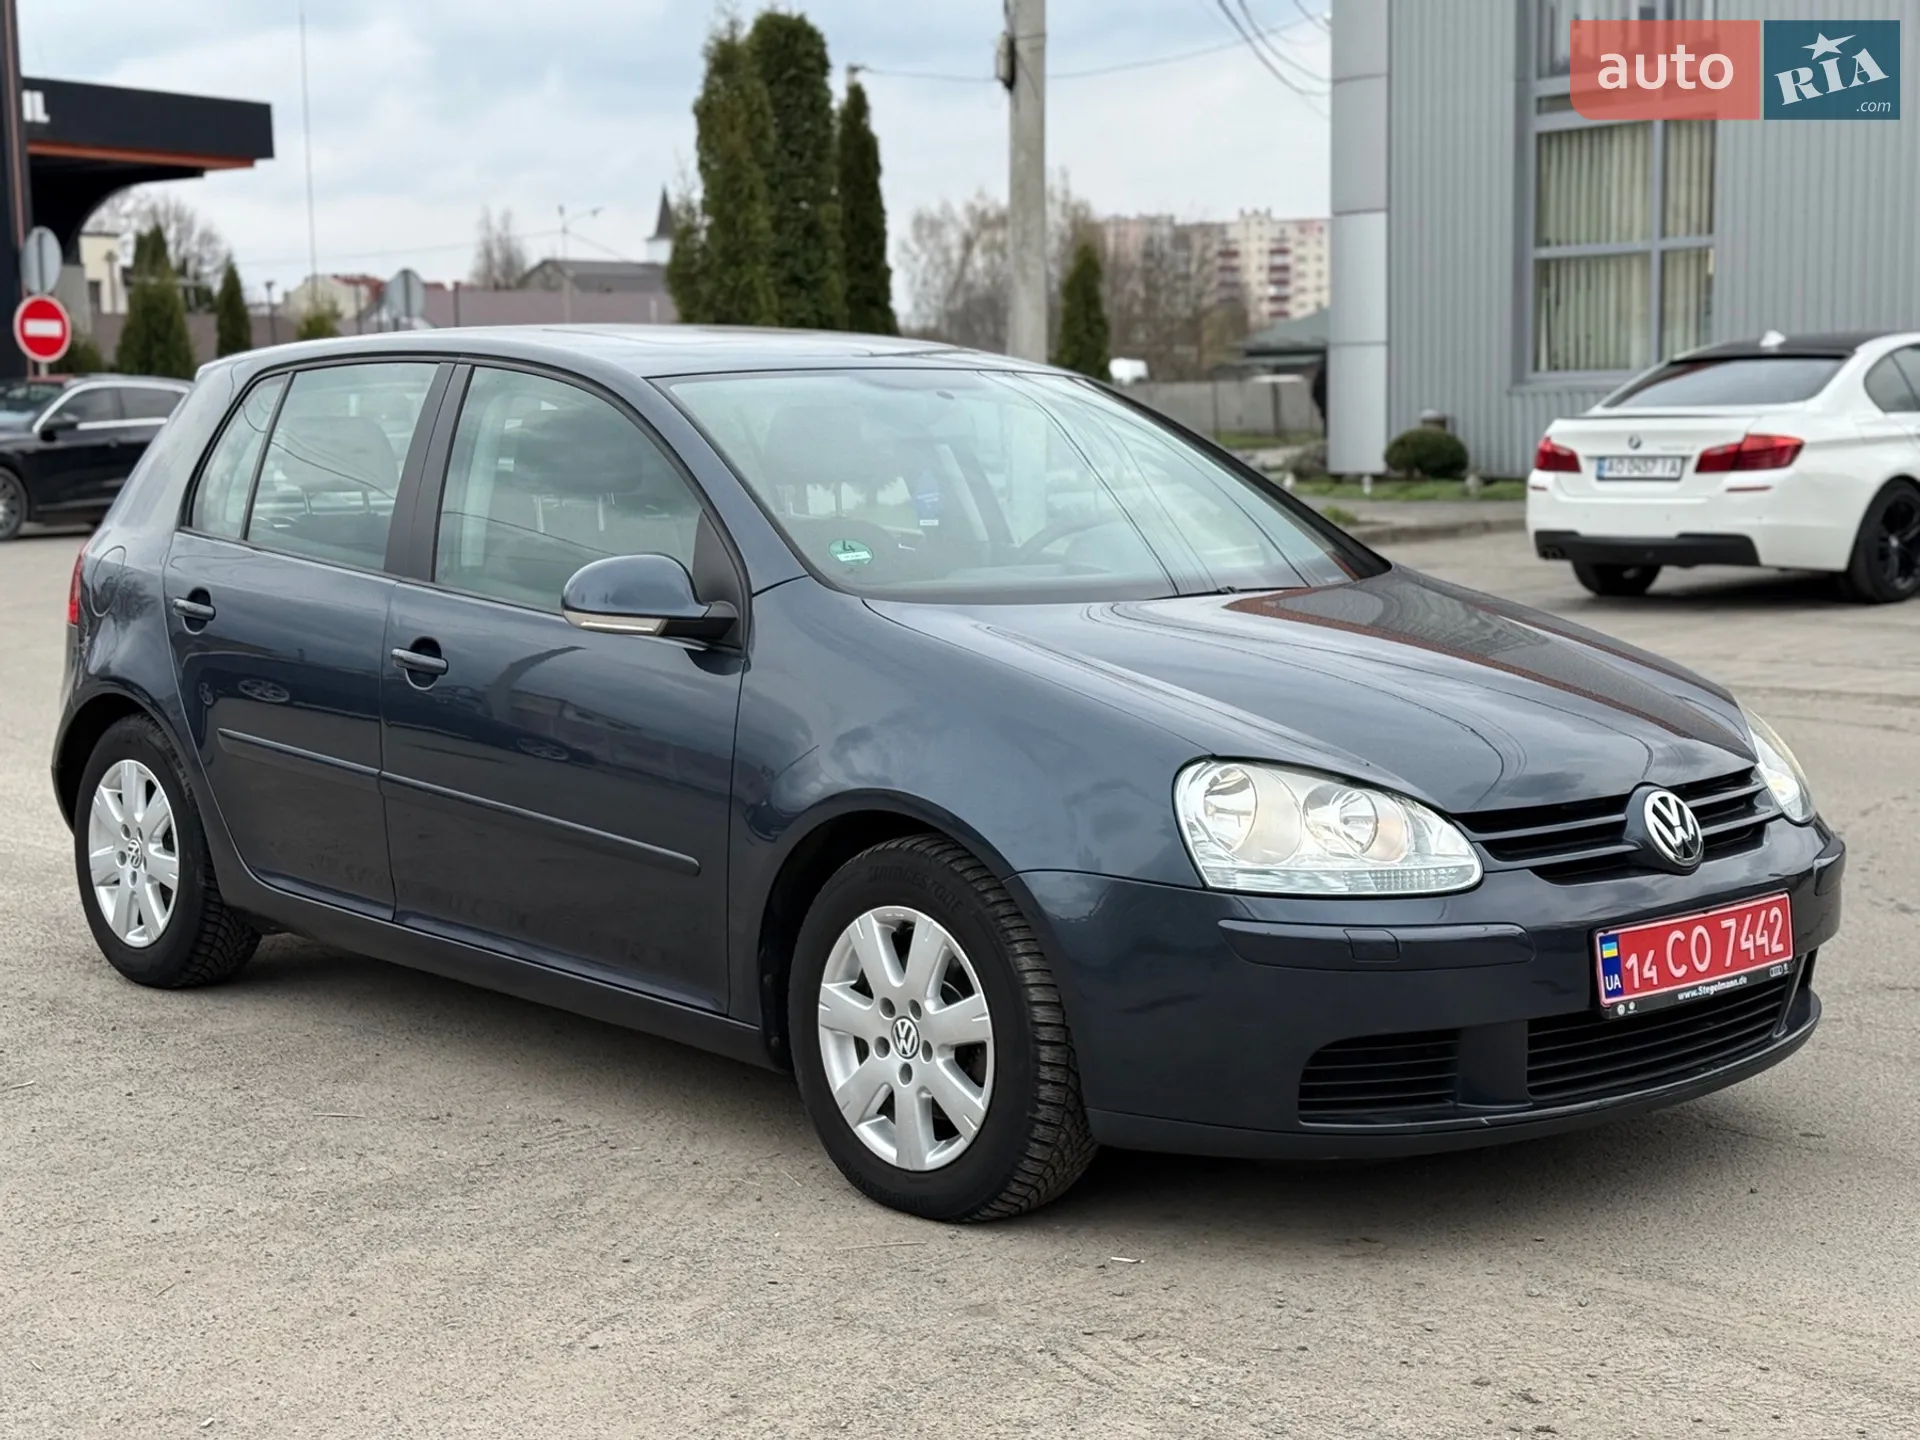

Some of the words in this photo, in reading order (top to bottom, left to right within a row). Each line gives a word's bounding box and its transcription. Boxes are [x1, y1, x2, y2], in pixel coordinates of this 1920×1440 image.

[1625, 949, 1658, 989] 14
[1666, 925, 1712, 978] CO
[1720, 906, 1784, 967] 7442
[1605, 974, 1621, 991] UA
[1677, 976, 1748, 1000] www.Stegelmann.de
